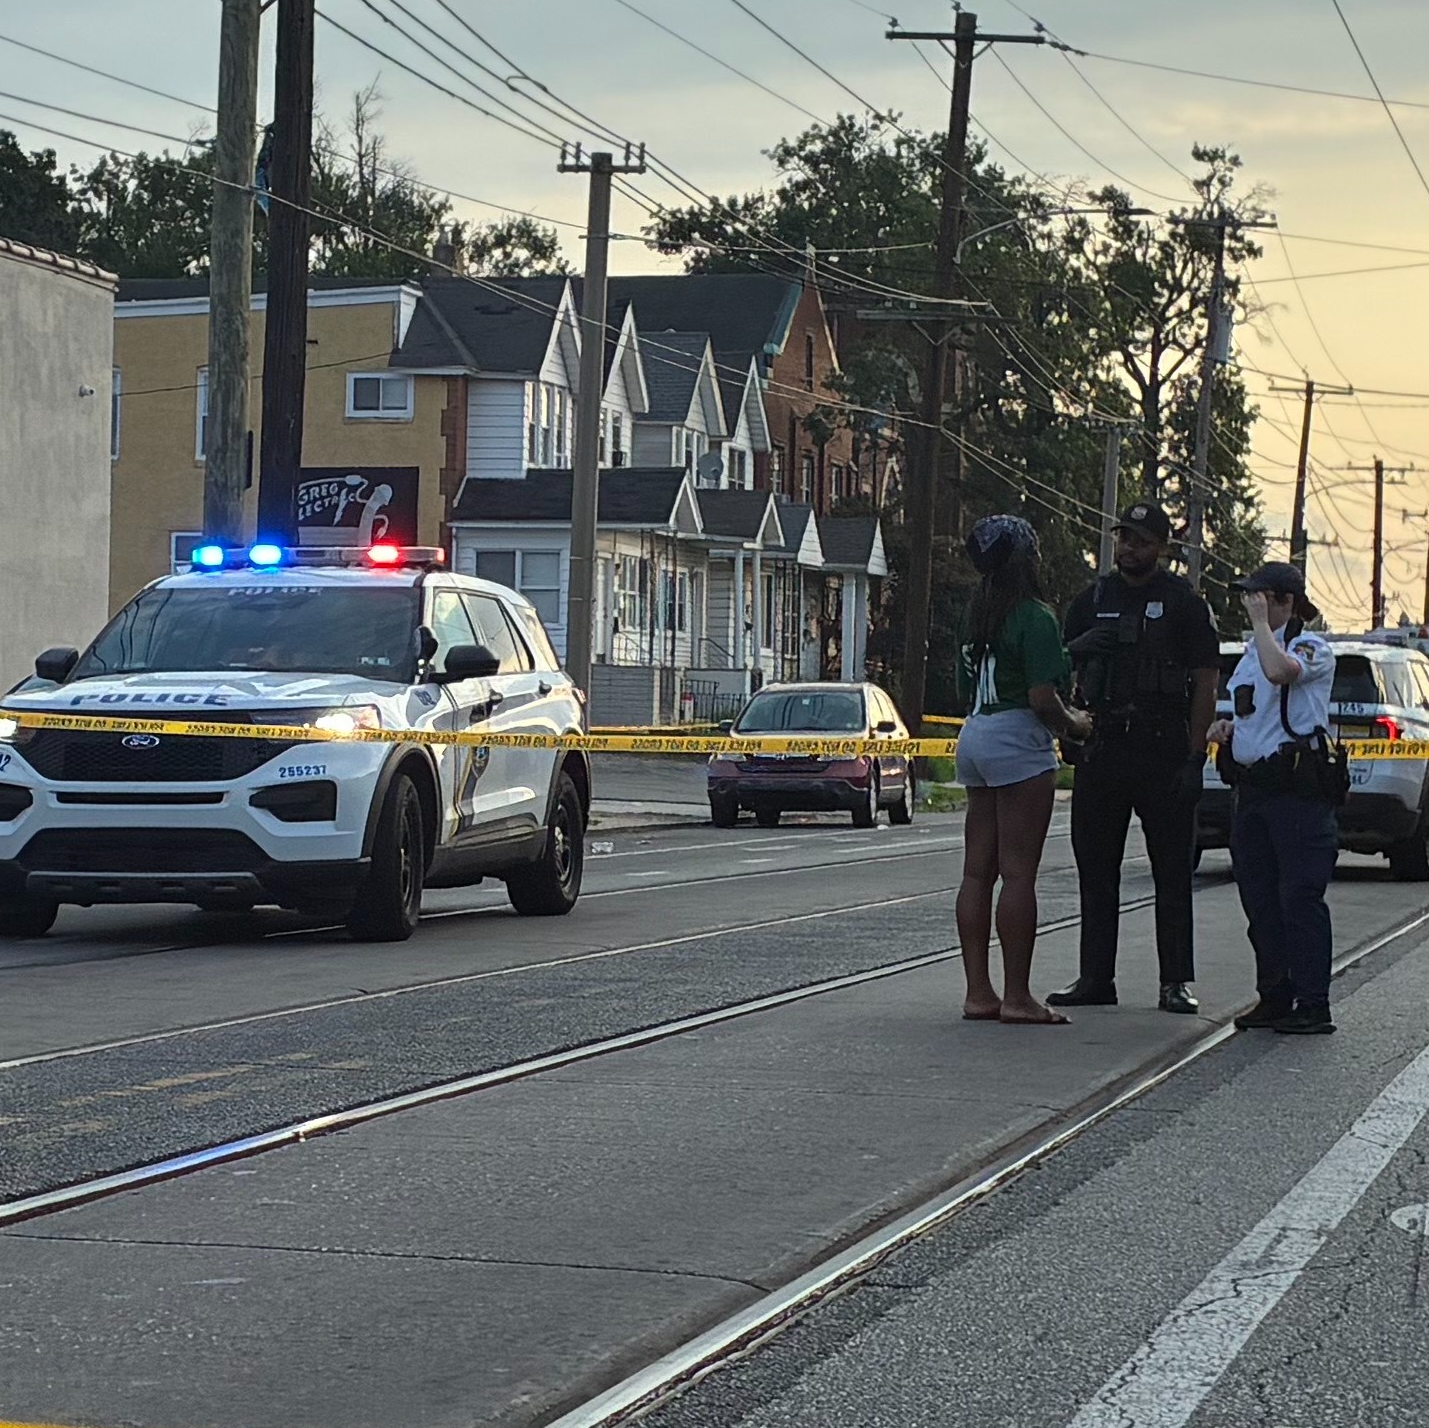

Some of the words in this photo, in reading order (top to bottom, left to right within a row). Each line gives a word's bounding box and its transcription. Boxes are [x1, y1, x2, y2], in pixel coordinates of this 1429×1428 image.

[298, 483, 339, 504] GREG
[70, 693, 231, 706] POLICE
[279, 765, 327, 778] 255237
